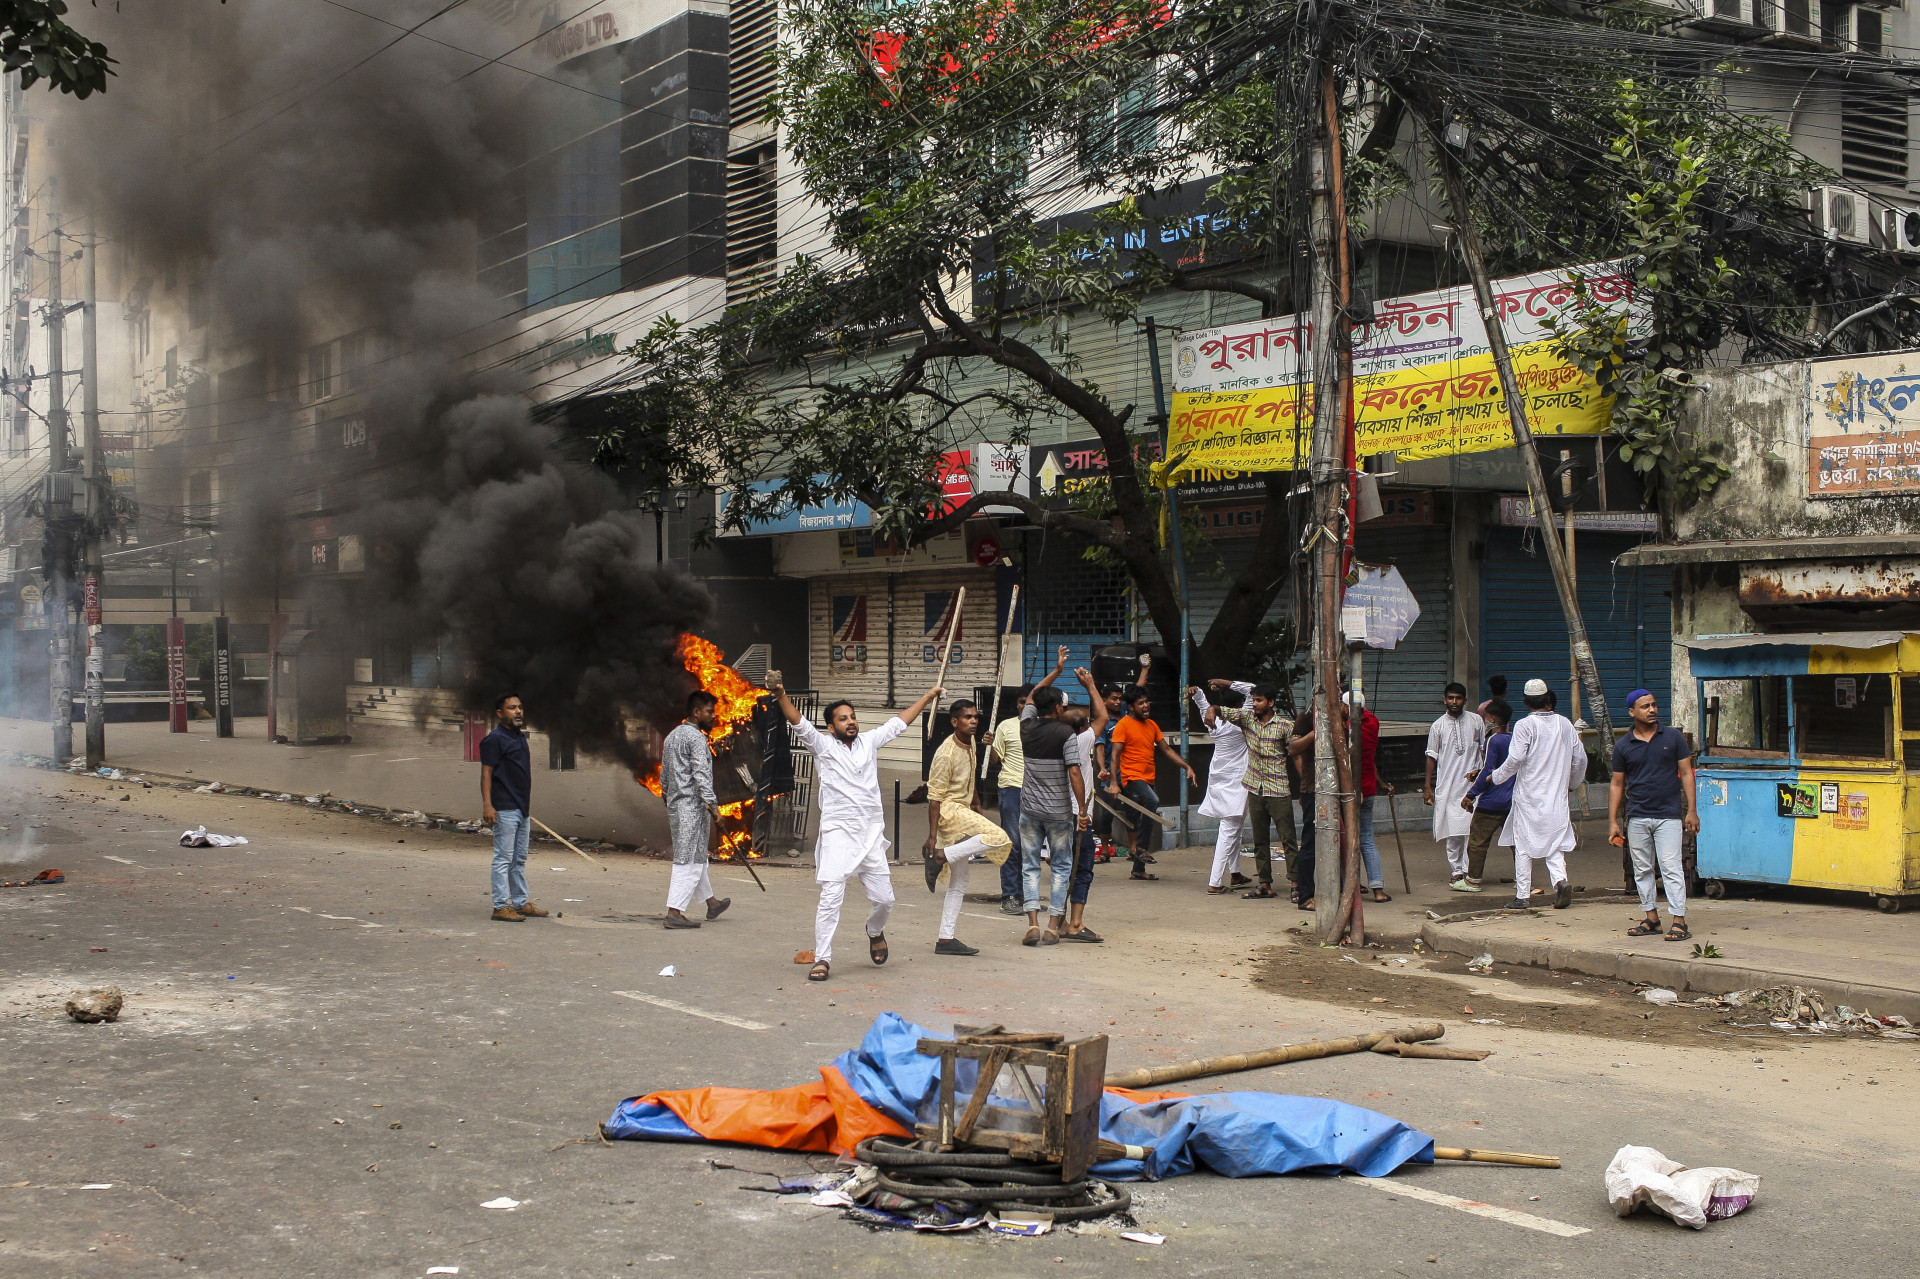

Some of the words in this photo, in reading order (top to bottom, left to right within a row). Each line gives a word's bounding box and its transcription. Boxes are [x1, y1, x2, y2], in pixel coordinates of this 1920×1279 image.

[585, 12, 619, 44] LTD.
[1401, 352, 1449, 367] একাদশ
[1219, 376, 1261, 390] মানবিক
[1263, 375, 1274, 384] ও
[1188, 391, 1214, 405] ভর্তি
[1446, 401, 1494, 422] শাখায়
[343, 418, 367, 449] UCB
[1176, 404, 1252, 443] পুরানা
[832, 644, 868, 663] BCB
[922, 644, 964, 664] BCB
[173, 645, 186, 705] HITACHI
[217, 649, 230, 706] SAMSUNG
